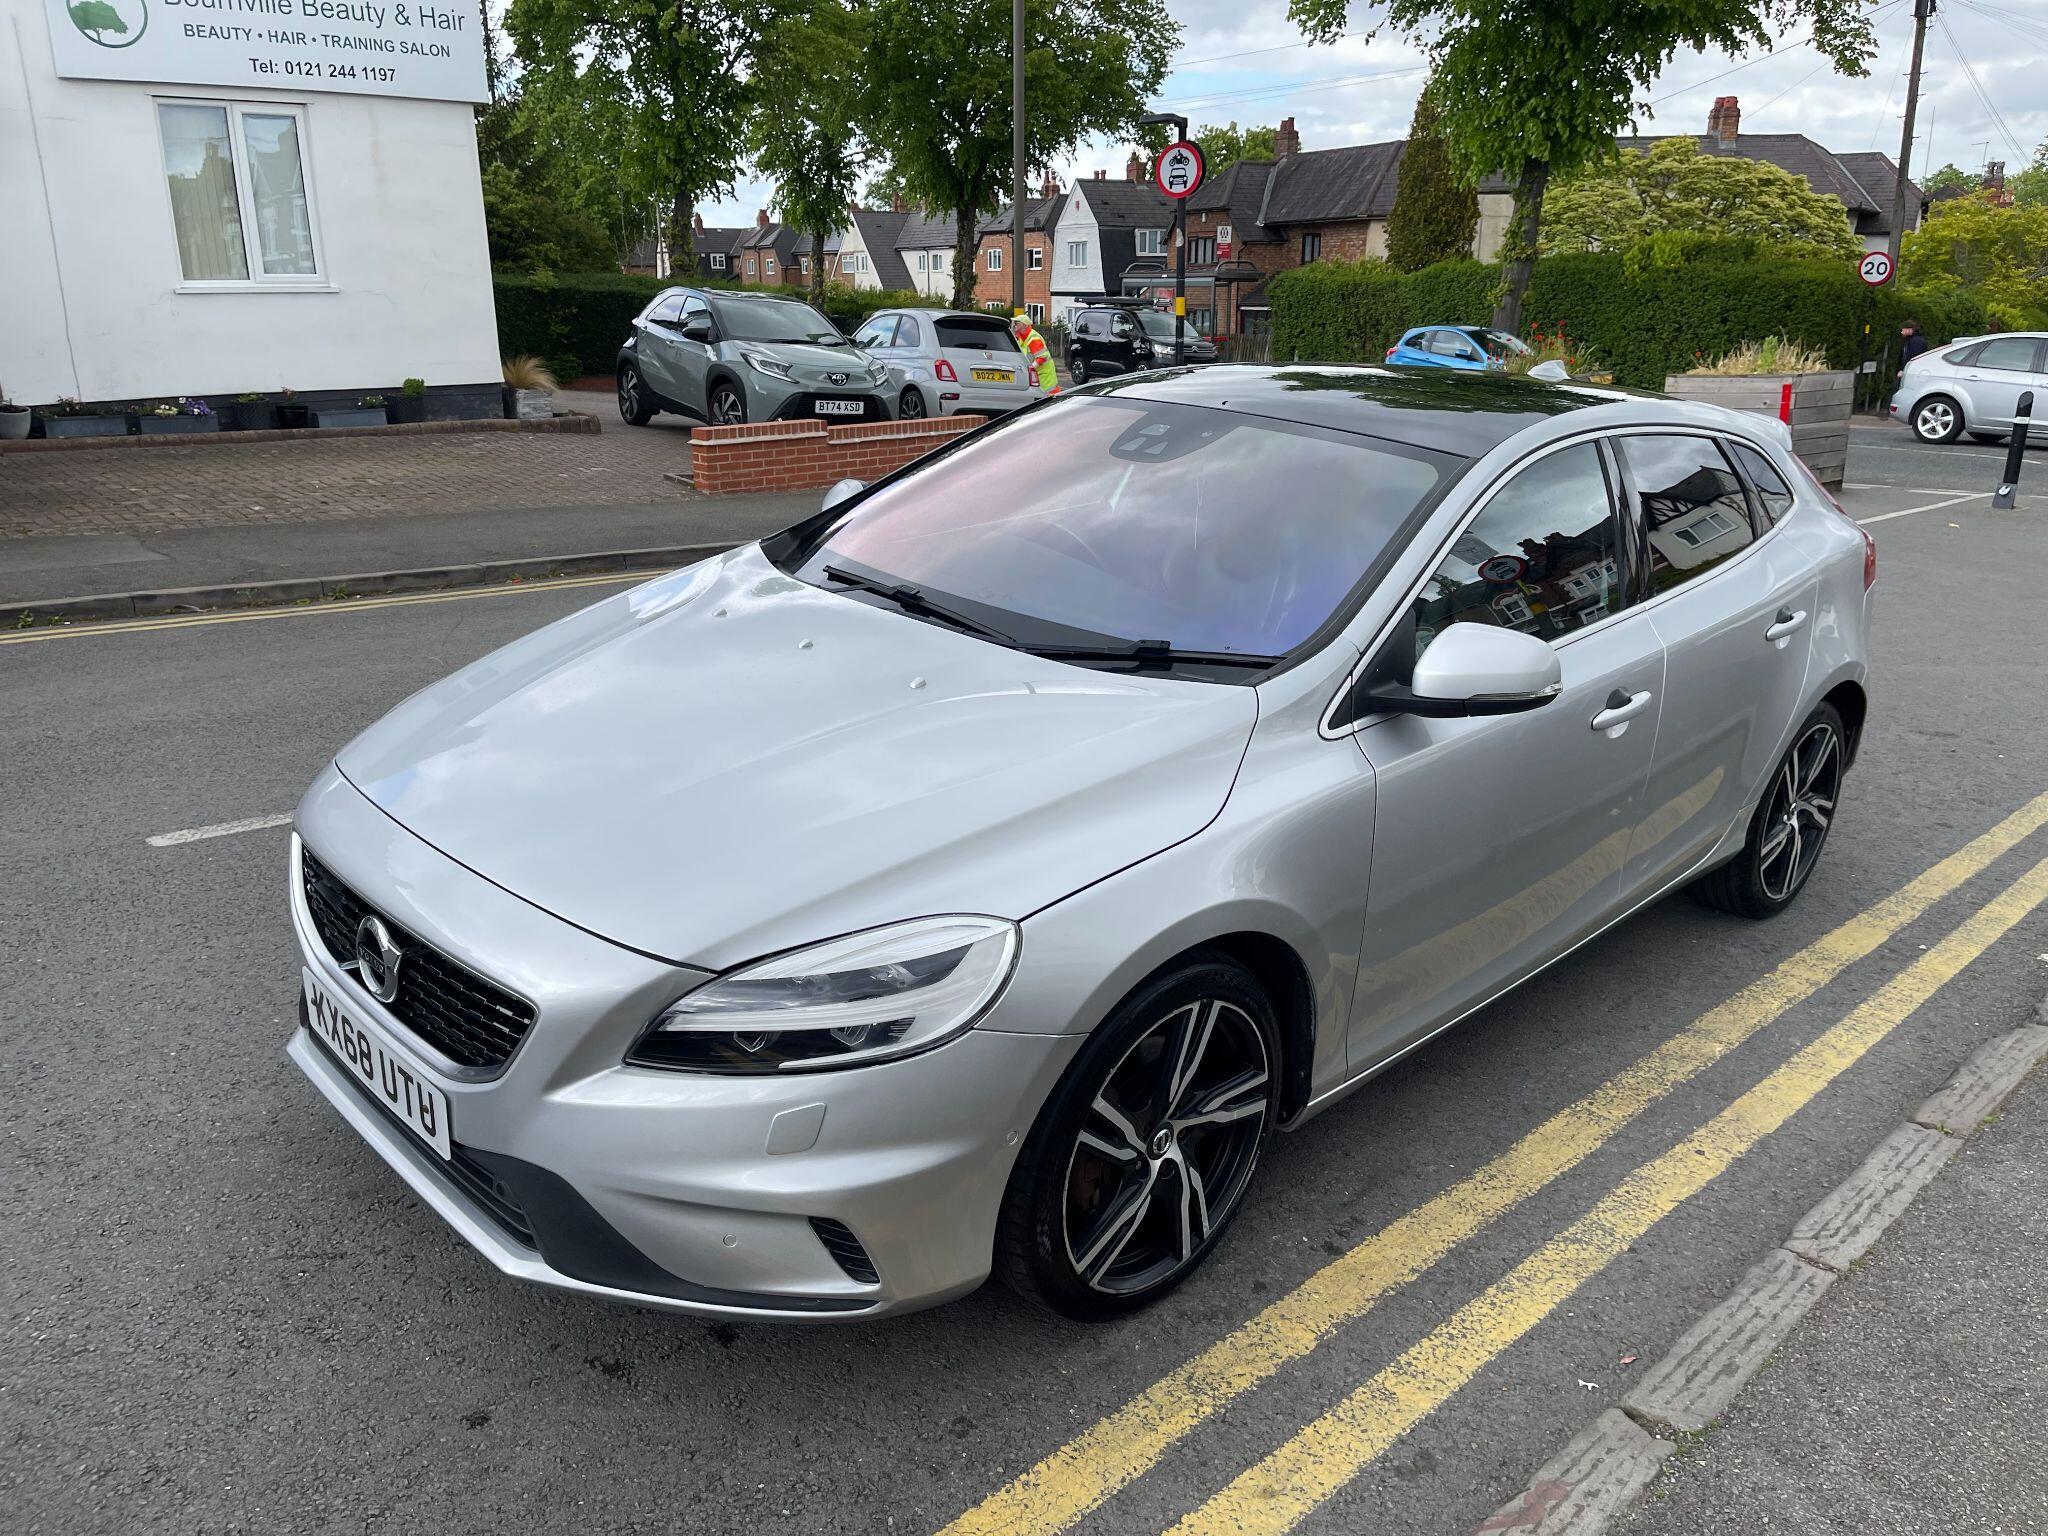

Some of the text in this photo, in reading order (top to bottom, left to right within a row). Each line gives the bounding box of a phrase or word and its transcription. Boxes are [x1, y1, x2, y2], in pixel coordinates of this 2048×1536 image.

[164, 0, 465, 31] rnville Beauty & Hair
[183, 23, 451, 58] BEAUTY HAIR TRAINING SALON
[249, 58, 396, 82] Tel: 0121 244 1197
[1863, 261, 1888, 275] 20
[819, 401, 861, 412] BT74 XSD
[311, 983, 437, 1138] KX68 UTU
